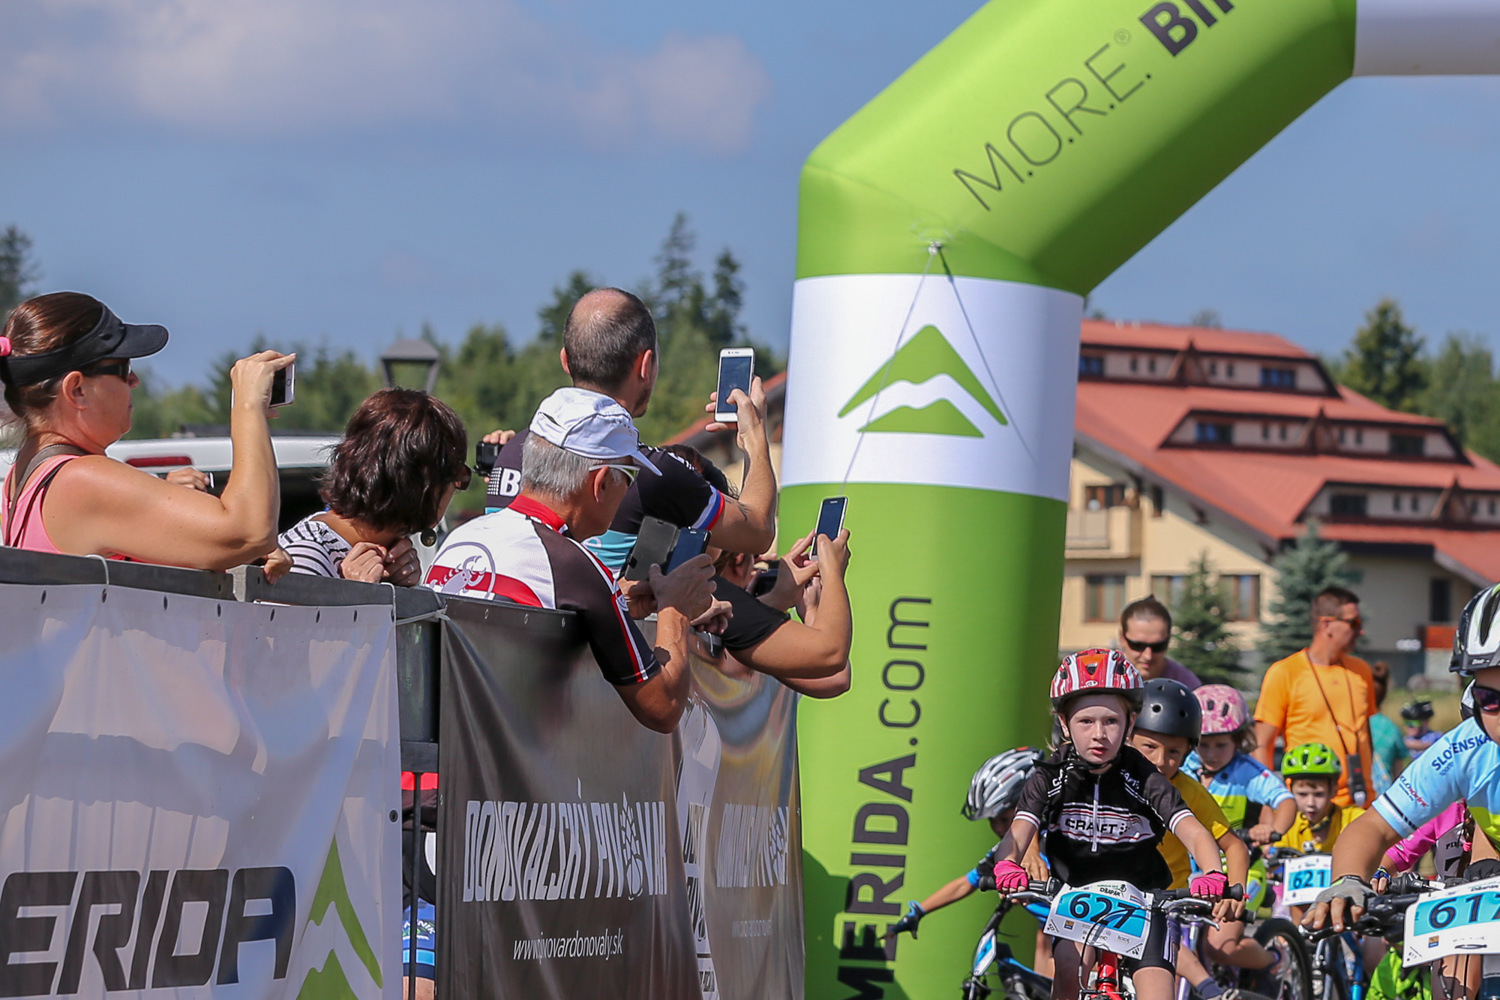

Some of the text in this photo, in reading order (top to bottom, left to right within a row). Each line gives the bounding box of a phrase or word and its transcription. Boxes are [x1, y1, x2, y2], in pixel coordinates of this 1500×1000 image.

[1139, 0, 1234, 57] BI
[1431, 734, 1493, 771] SLOENSKA
[1293, 869, 1326, 890] 621
[1069, 893, 1137, 930] 627
[0, 866, 296, 998] ERIDA
